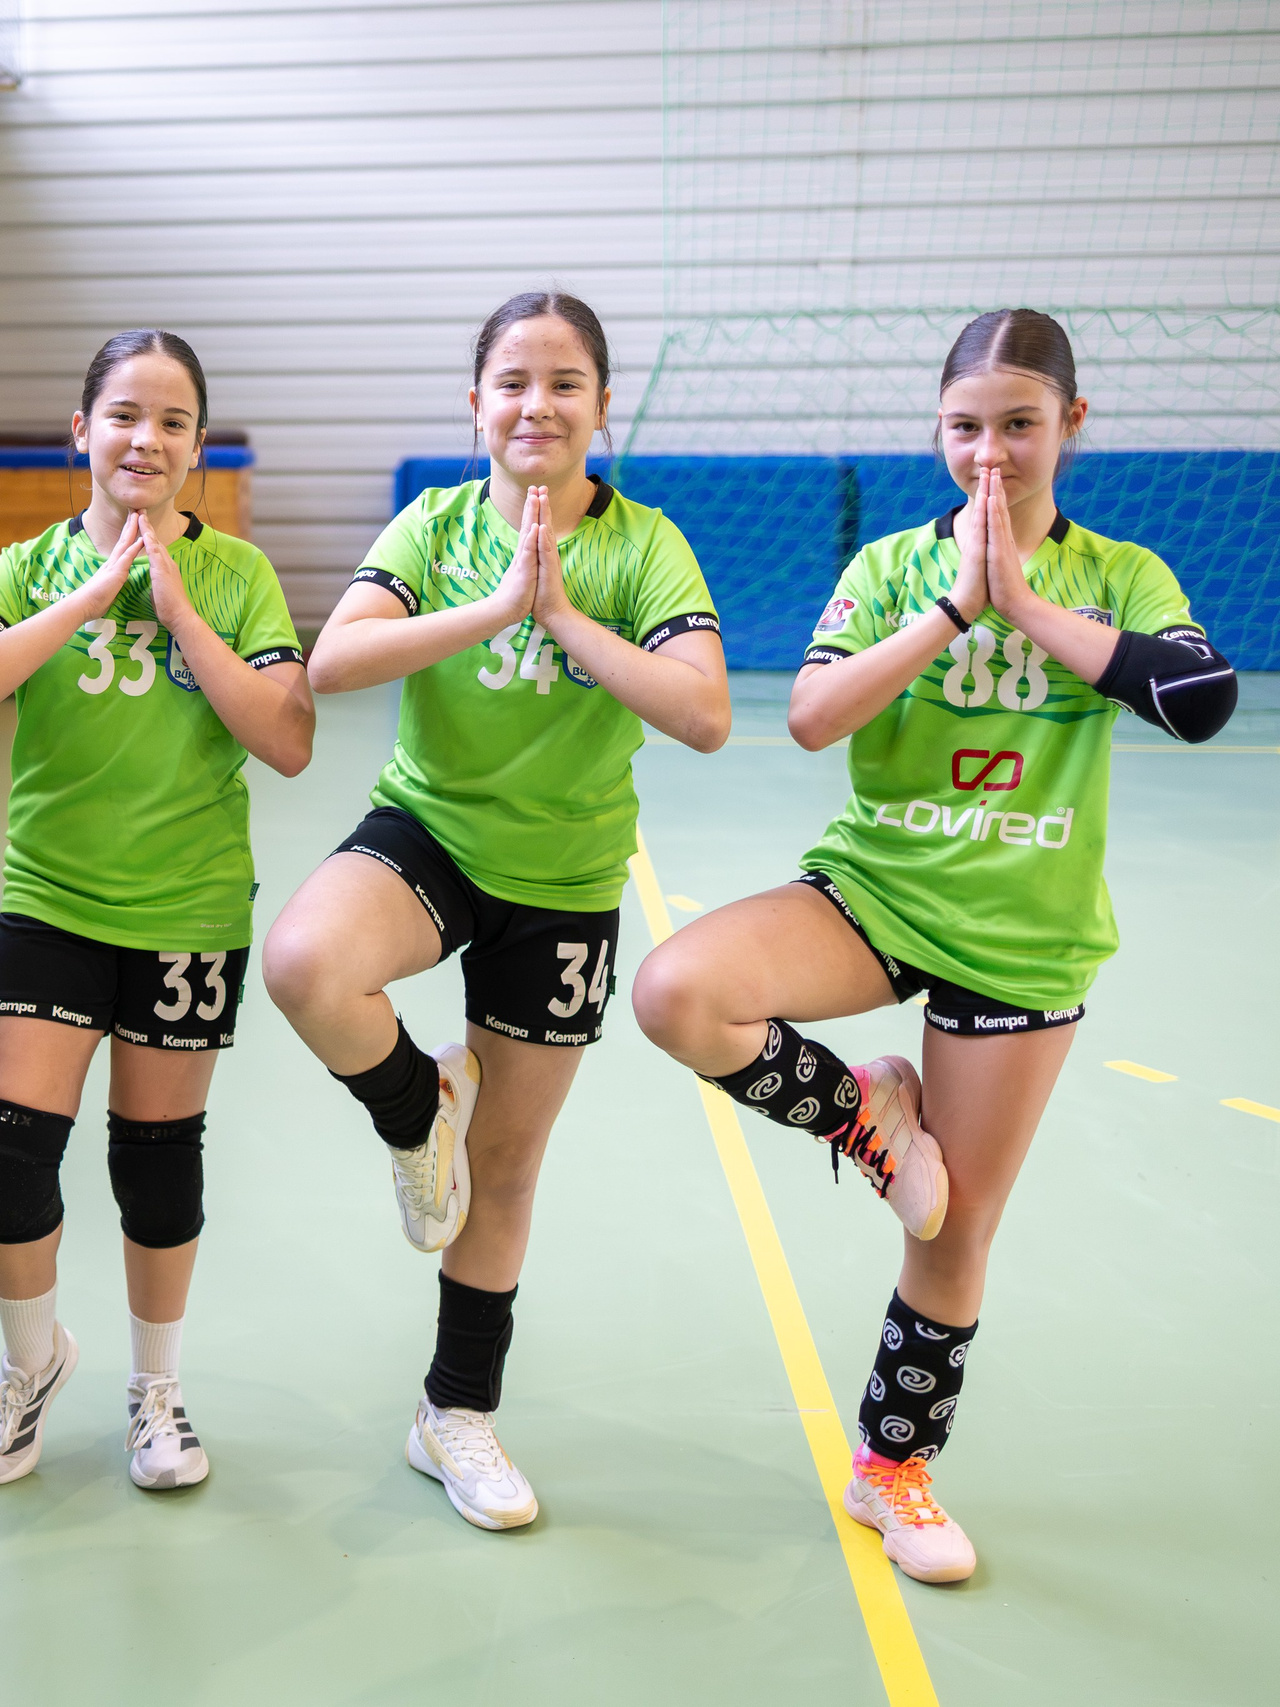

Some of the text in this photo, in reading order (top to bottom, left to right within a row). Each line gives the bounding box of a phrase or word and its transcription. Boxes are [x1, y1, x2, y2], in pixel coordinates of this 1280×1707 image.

[431, 558, 480, 581] Kempa
[77, 617, 158, 697] 33
[477, 621, 560, 695] 34
[942, 625, 1050, 711] 88
[875, 799, 1075, 850] covired
[350, 844, 445, 932] Kempa Kempa
[152, 950, 228, 1022] 33
[546, 938, 610, 1019] 34
[51, 1004, 93, 1026] Kempa
[114, 1022, 149, 1044] Kempa
[161, 1034, 208, 1051] Kempa
[485, 1013, 529, 1039] Kempa
[544, 1029, 588, 1046] Kempa
[926, 1006, 959, 1029] Kempa
[974, 1015, 1029, 1031] Kempa
